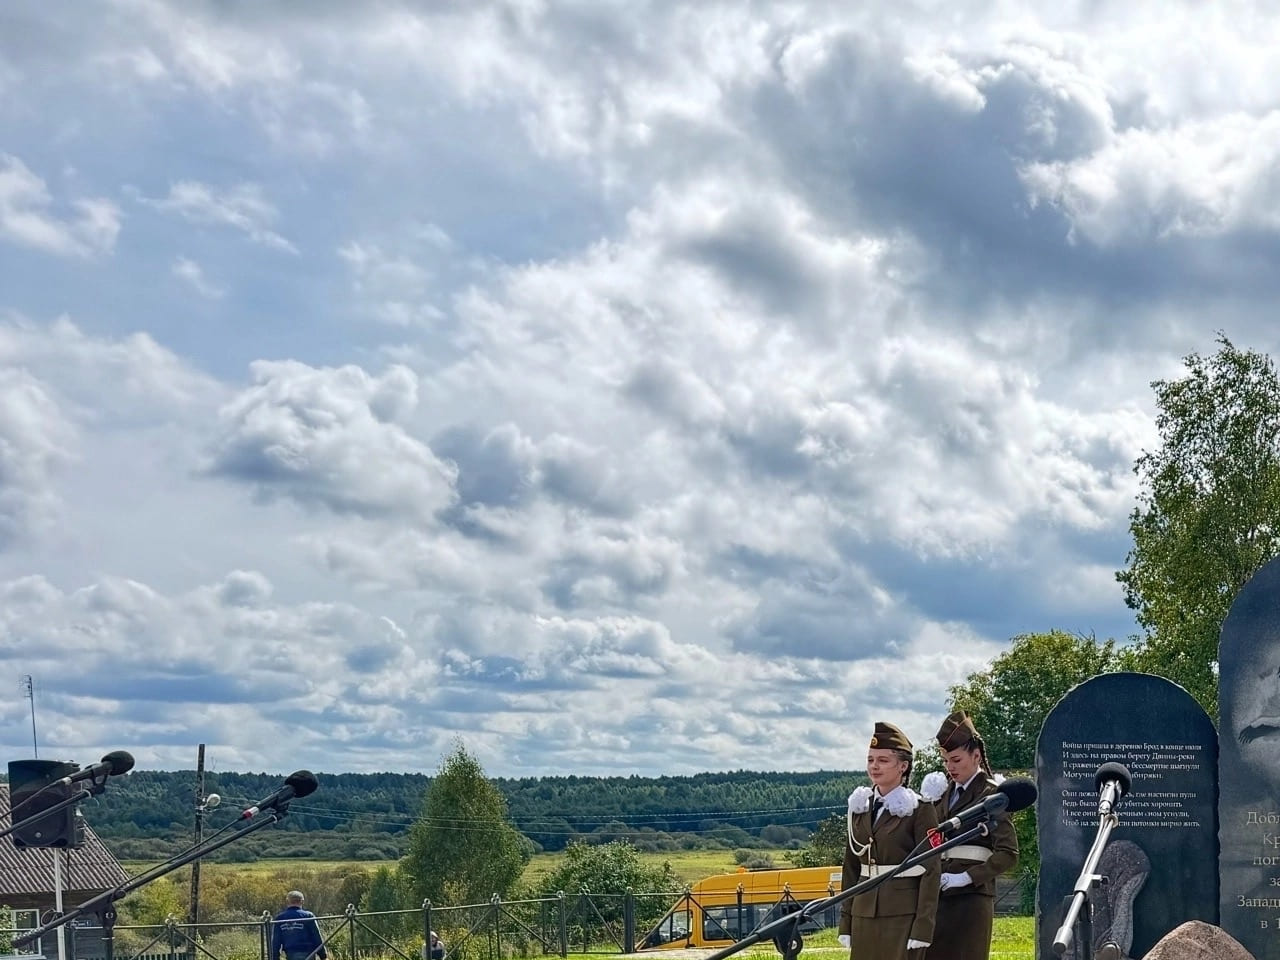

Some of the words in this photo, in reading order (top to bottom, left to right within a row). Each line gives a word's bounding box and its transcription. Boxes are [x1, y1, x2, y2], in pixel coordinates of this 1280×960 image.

[1143, 742, 1160, 752] Брод
[1127, 752, 1151, 761] берегу
[1131, 762, 1169, 771] бессмертие
[1124, 800, 1149, 808] убитых
